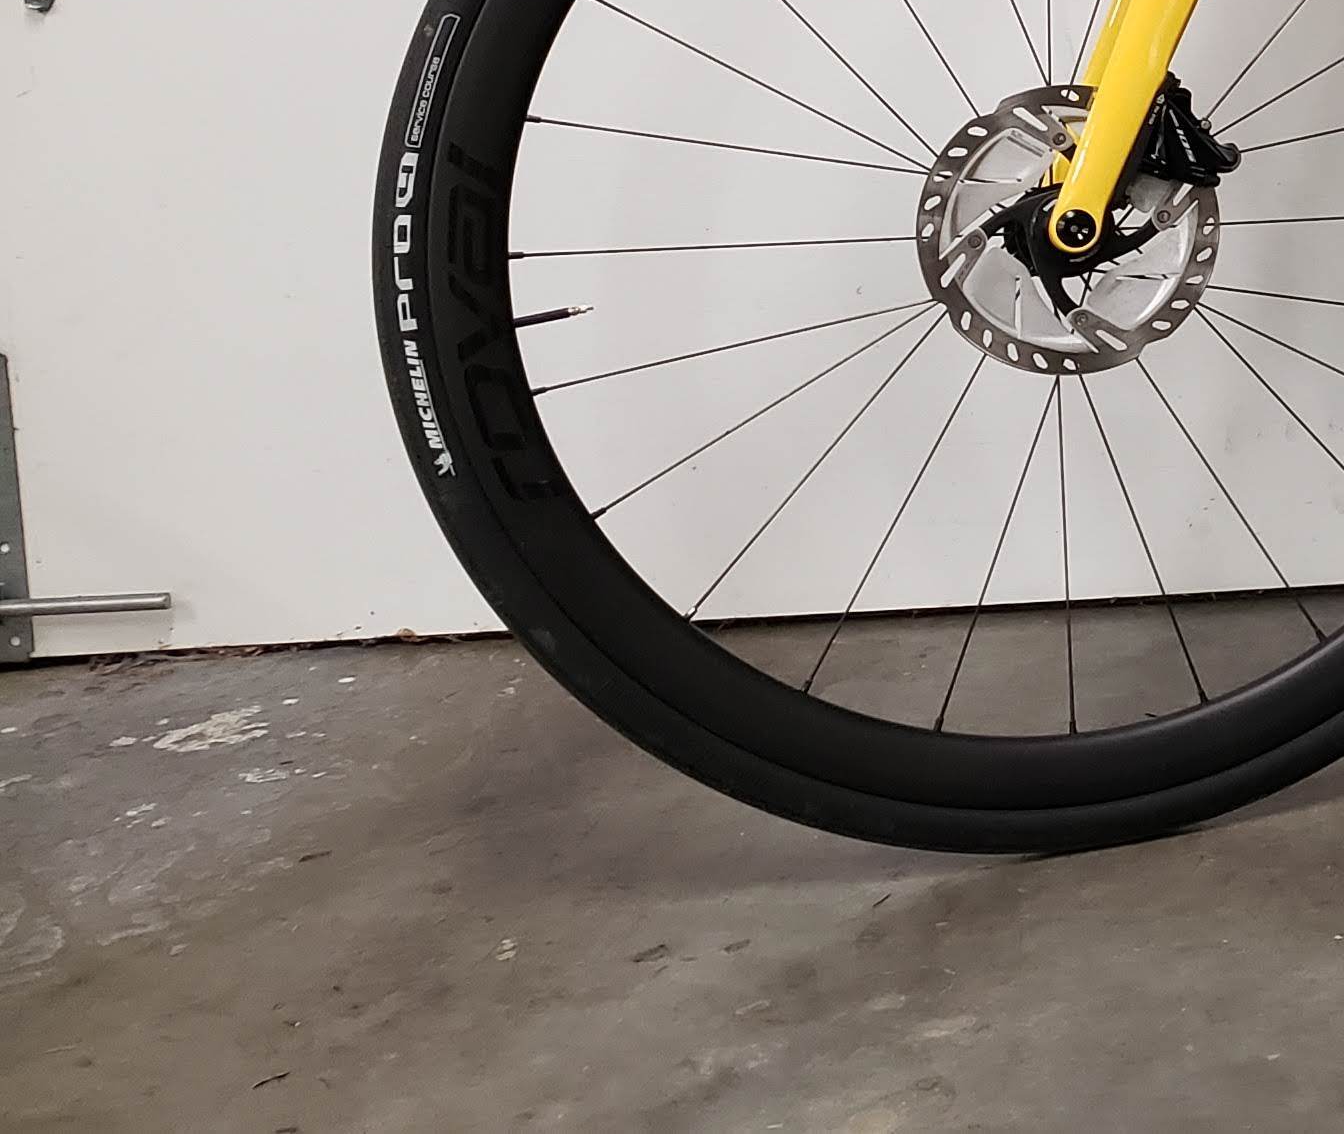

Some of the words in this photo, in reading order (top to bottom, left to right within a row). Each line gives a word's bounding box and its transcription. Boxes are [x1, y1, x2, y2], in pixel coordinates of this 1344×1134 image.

[410, 100, 428, 144] service
[421, 56, 441, 99] course
[403, 338, 443, 450] MICHELIN
